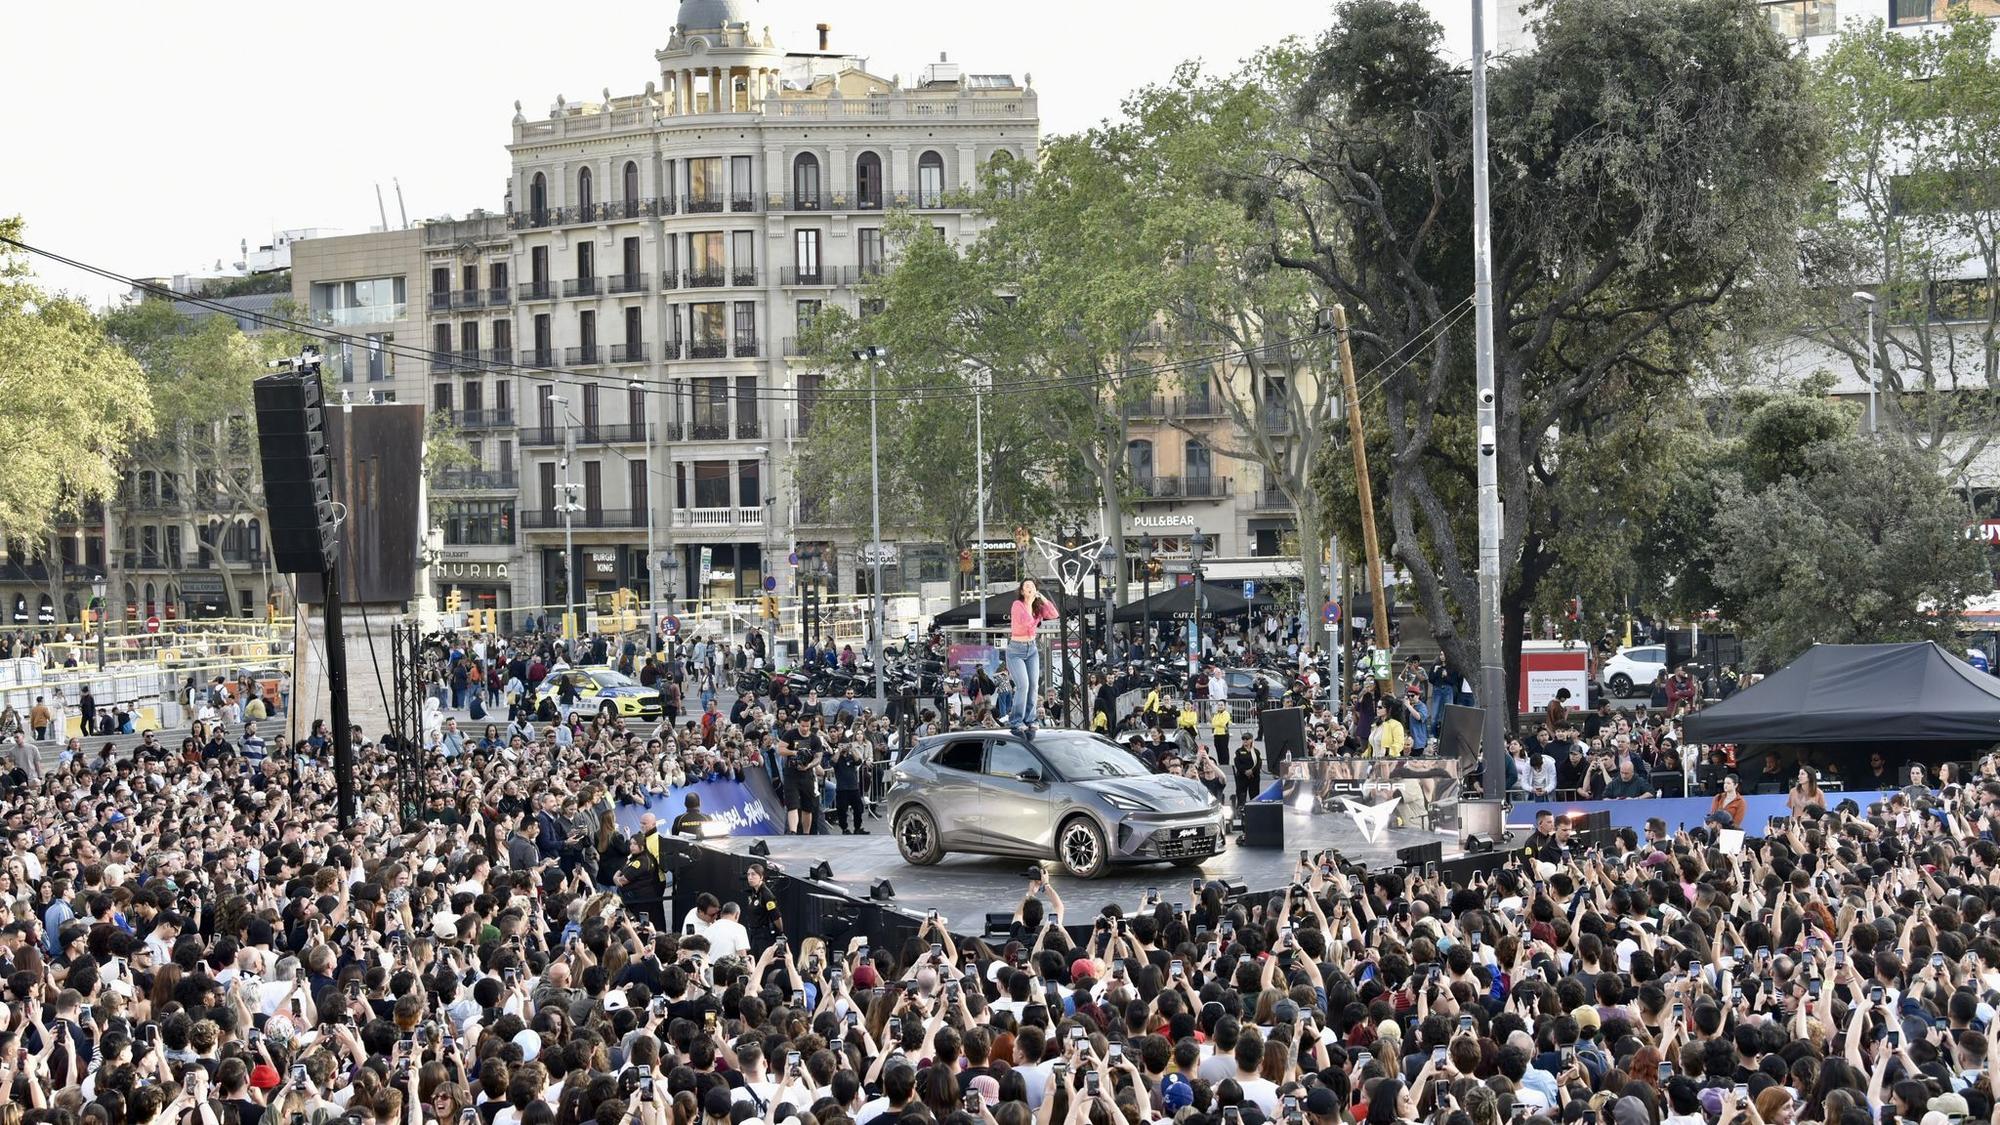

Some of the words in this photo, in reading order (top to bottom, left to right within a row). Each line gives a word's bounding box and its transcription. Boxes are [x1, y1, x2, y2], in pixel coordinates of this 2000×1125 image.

[1134, 515, 1194, 527] PULL&BEAR
[436, 563, 508, 578] NURIA
[596, 563, 613, 572] KING
[1334, 783, 1406, 792] CUPRA
